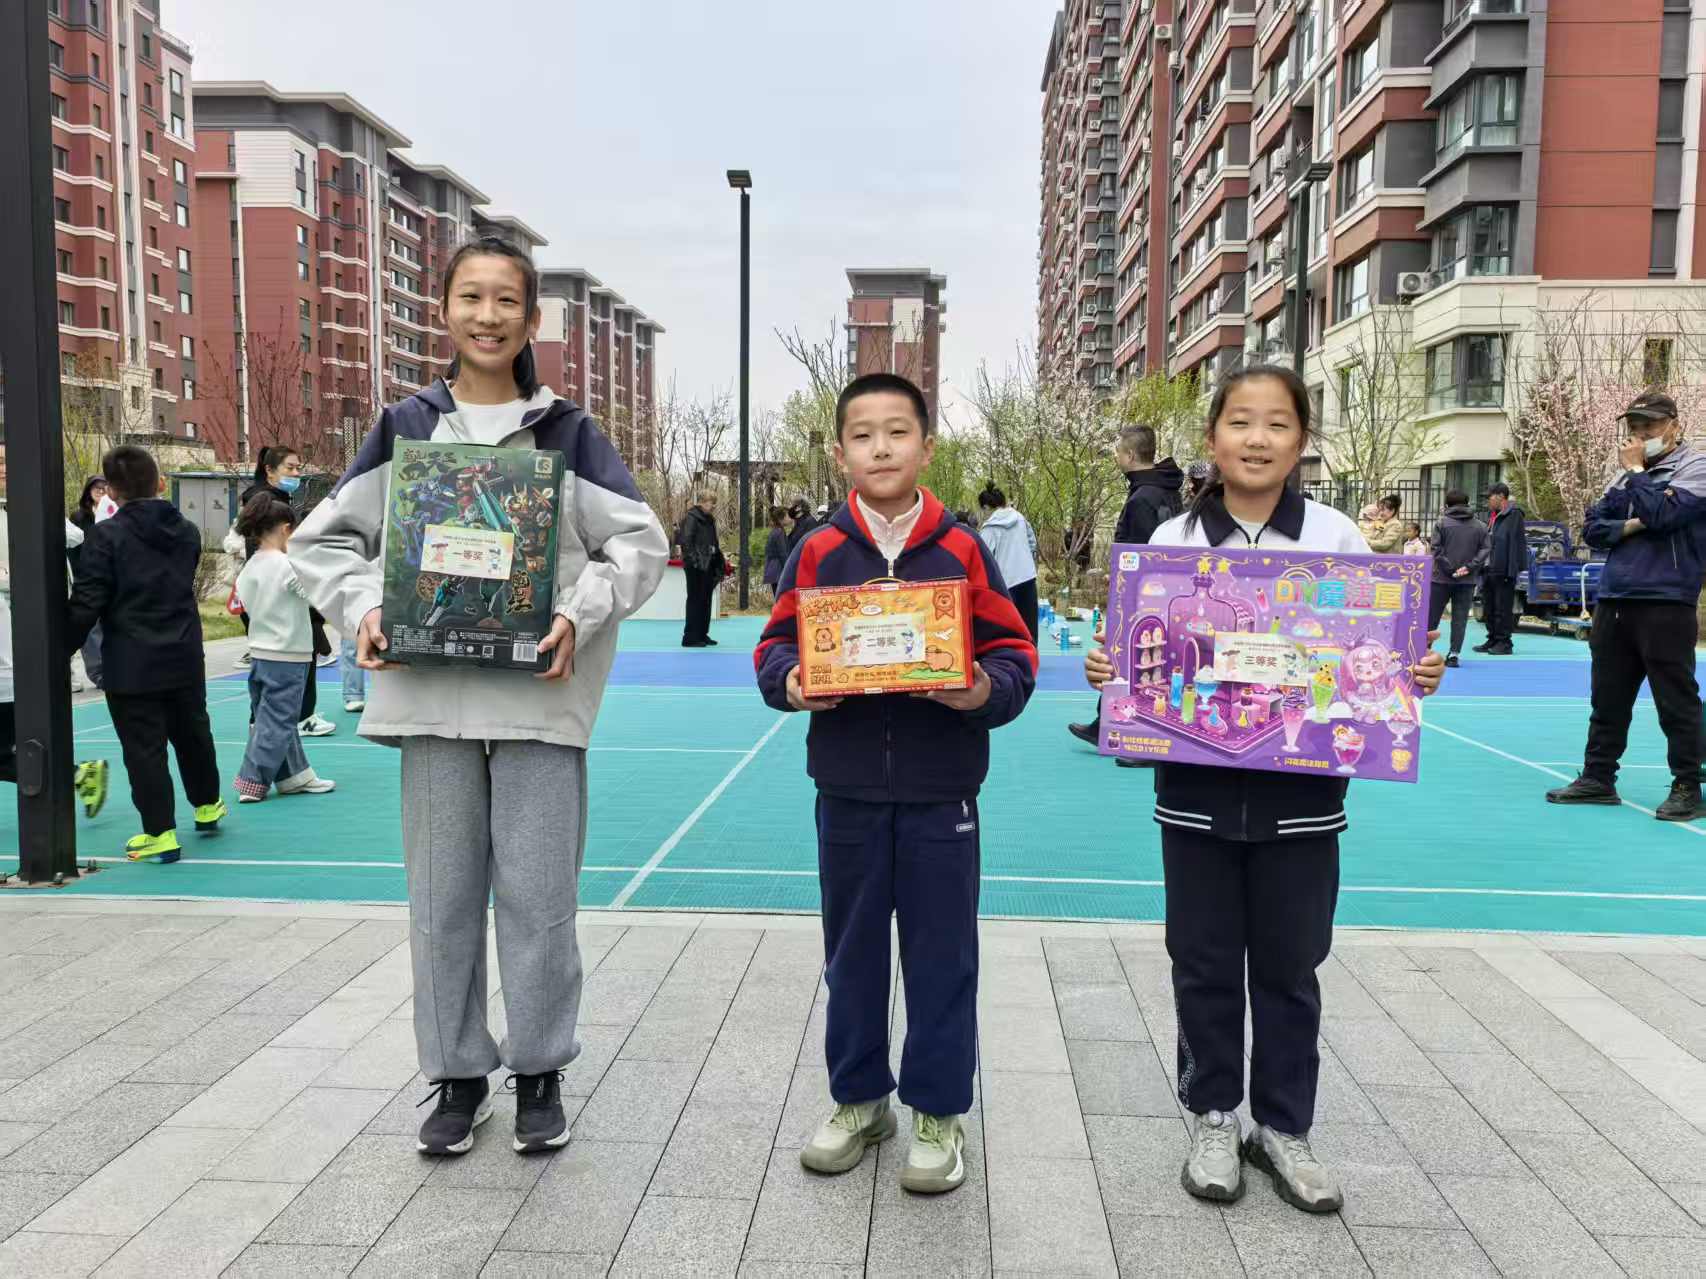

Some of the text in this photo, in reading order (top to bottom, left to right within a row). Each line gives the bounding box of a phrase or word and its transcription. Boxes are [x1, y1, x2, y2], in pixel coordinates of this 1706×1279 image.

[452, 549, 484, 561] 一等奖
[1276, 578, 1401, 609] DIY魔法屋
[866, 636, 897, 648] 二等奖
[1244, 654, 1277, 668] 三等奖
